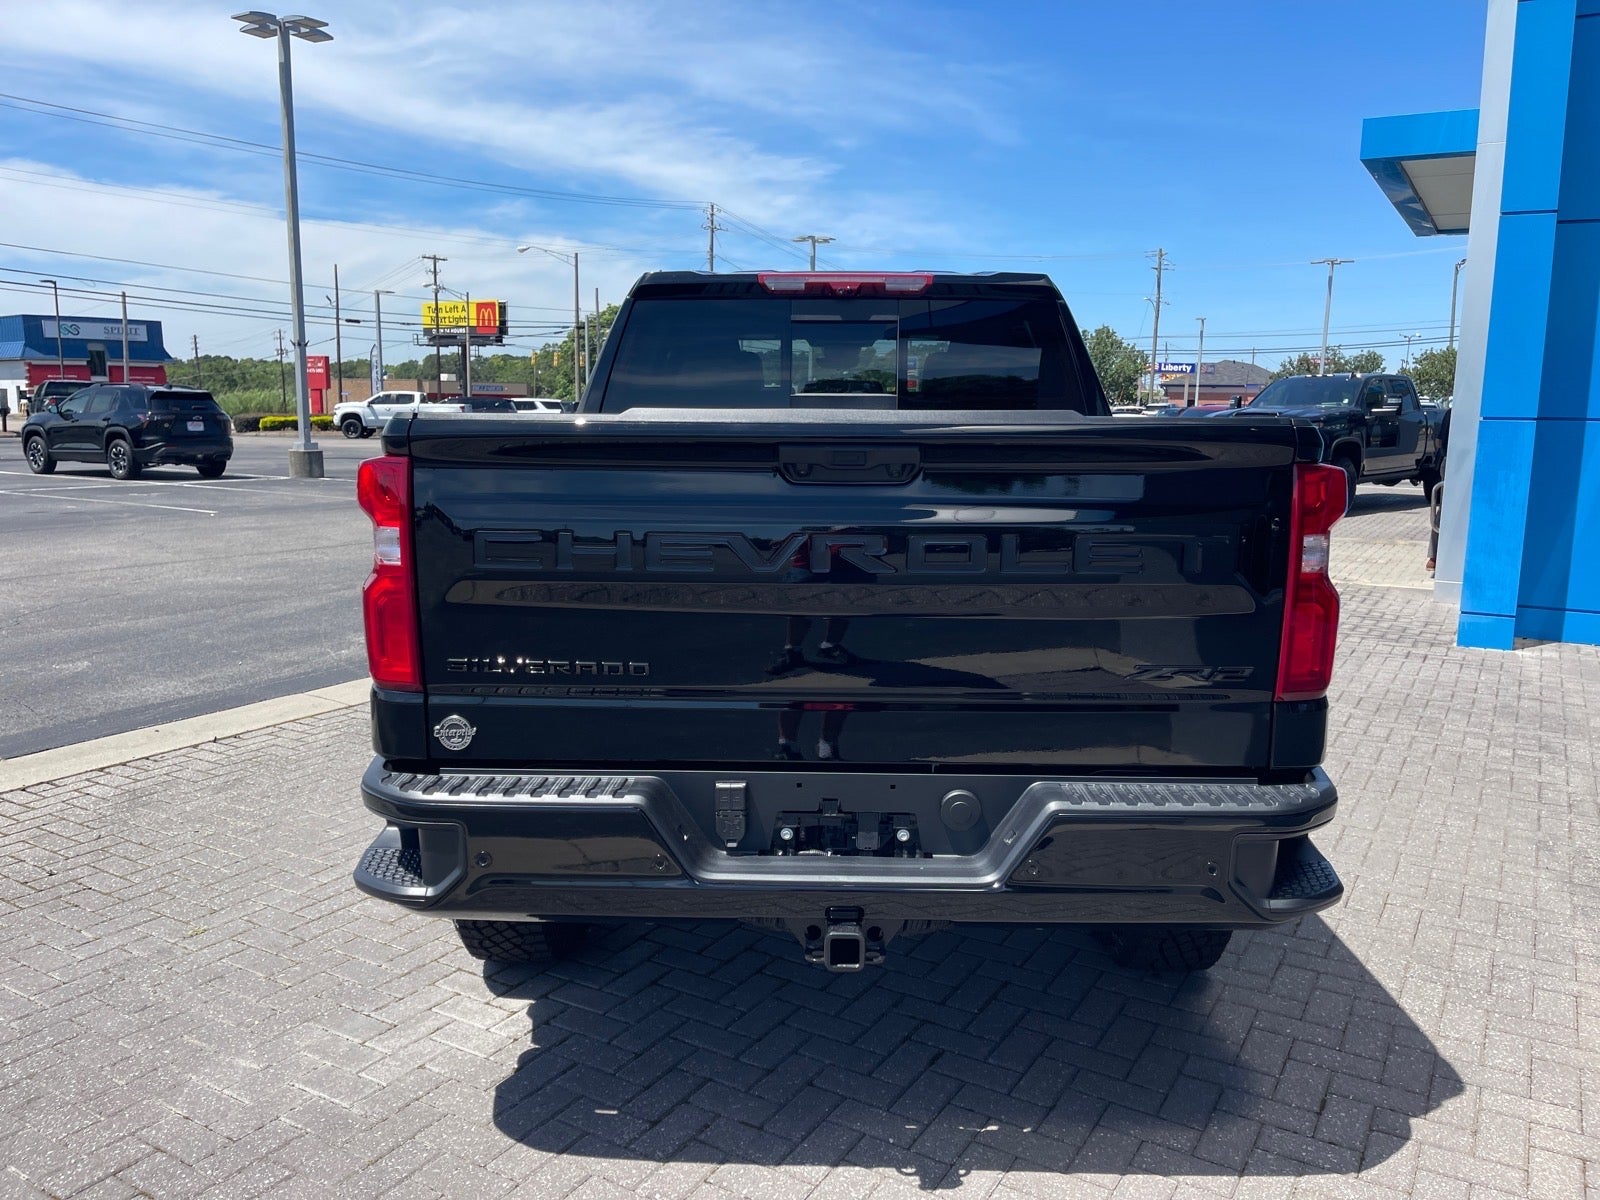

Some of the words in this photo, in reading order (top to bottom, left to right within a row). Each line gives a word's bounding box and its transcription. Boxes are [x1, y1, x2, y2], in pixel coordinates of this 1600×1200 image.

[427, 306, 443, 314] Tun
[430, 316, 446, 324] Nxt
[448, 316, 467, 324] Light
[103, 326, 139, 335] SPIIT
[1161, 363, 1192, 373] Liberty
[473, 529, 1230, 574] CHEVROLET
[448, 657, 650, 675] SILVERADO
[433, 726, 477, 739] Enterprise
